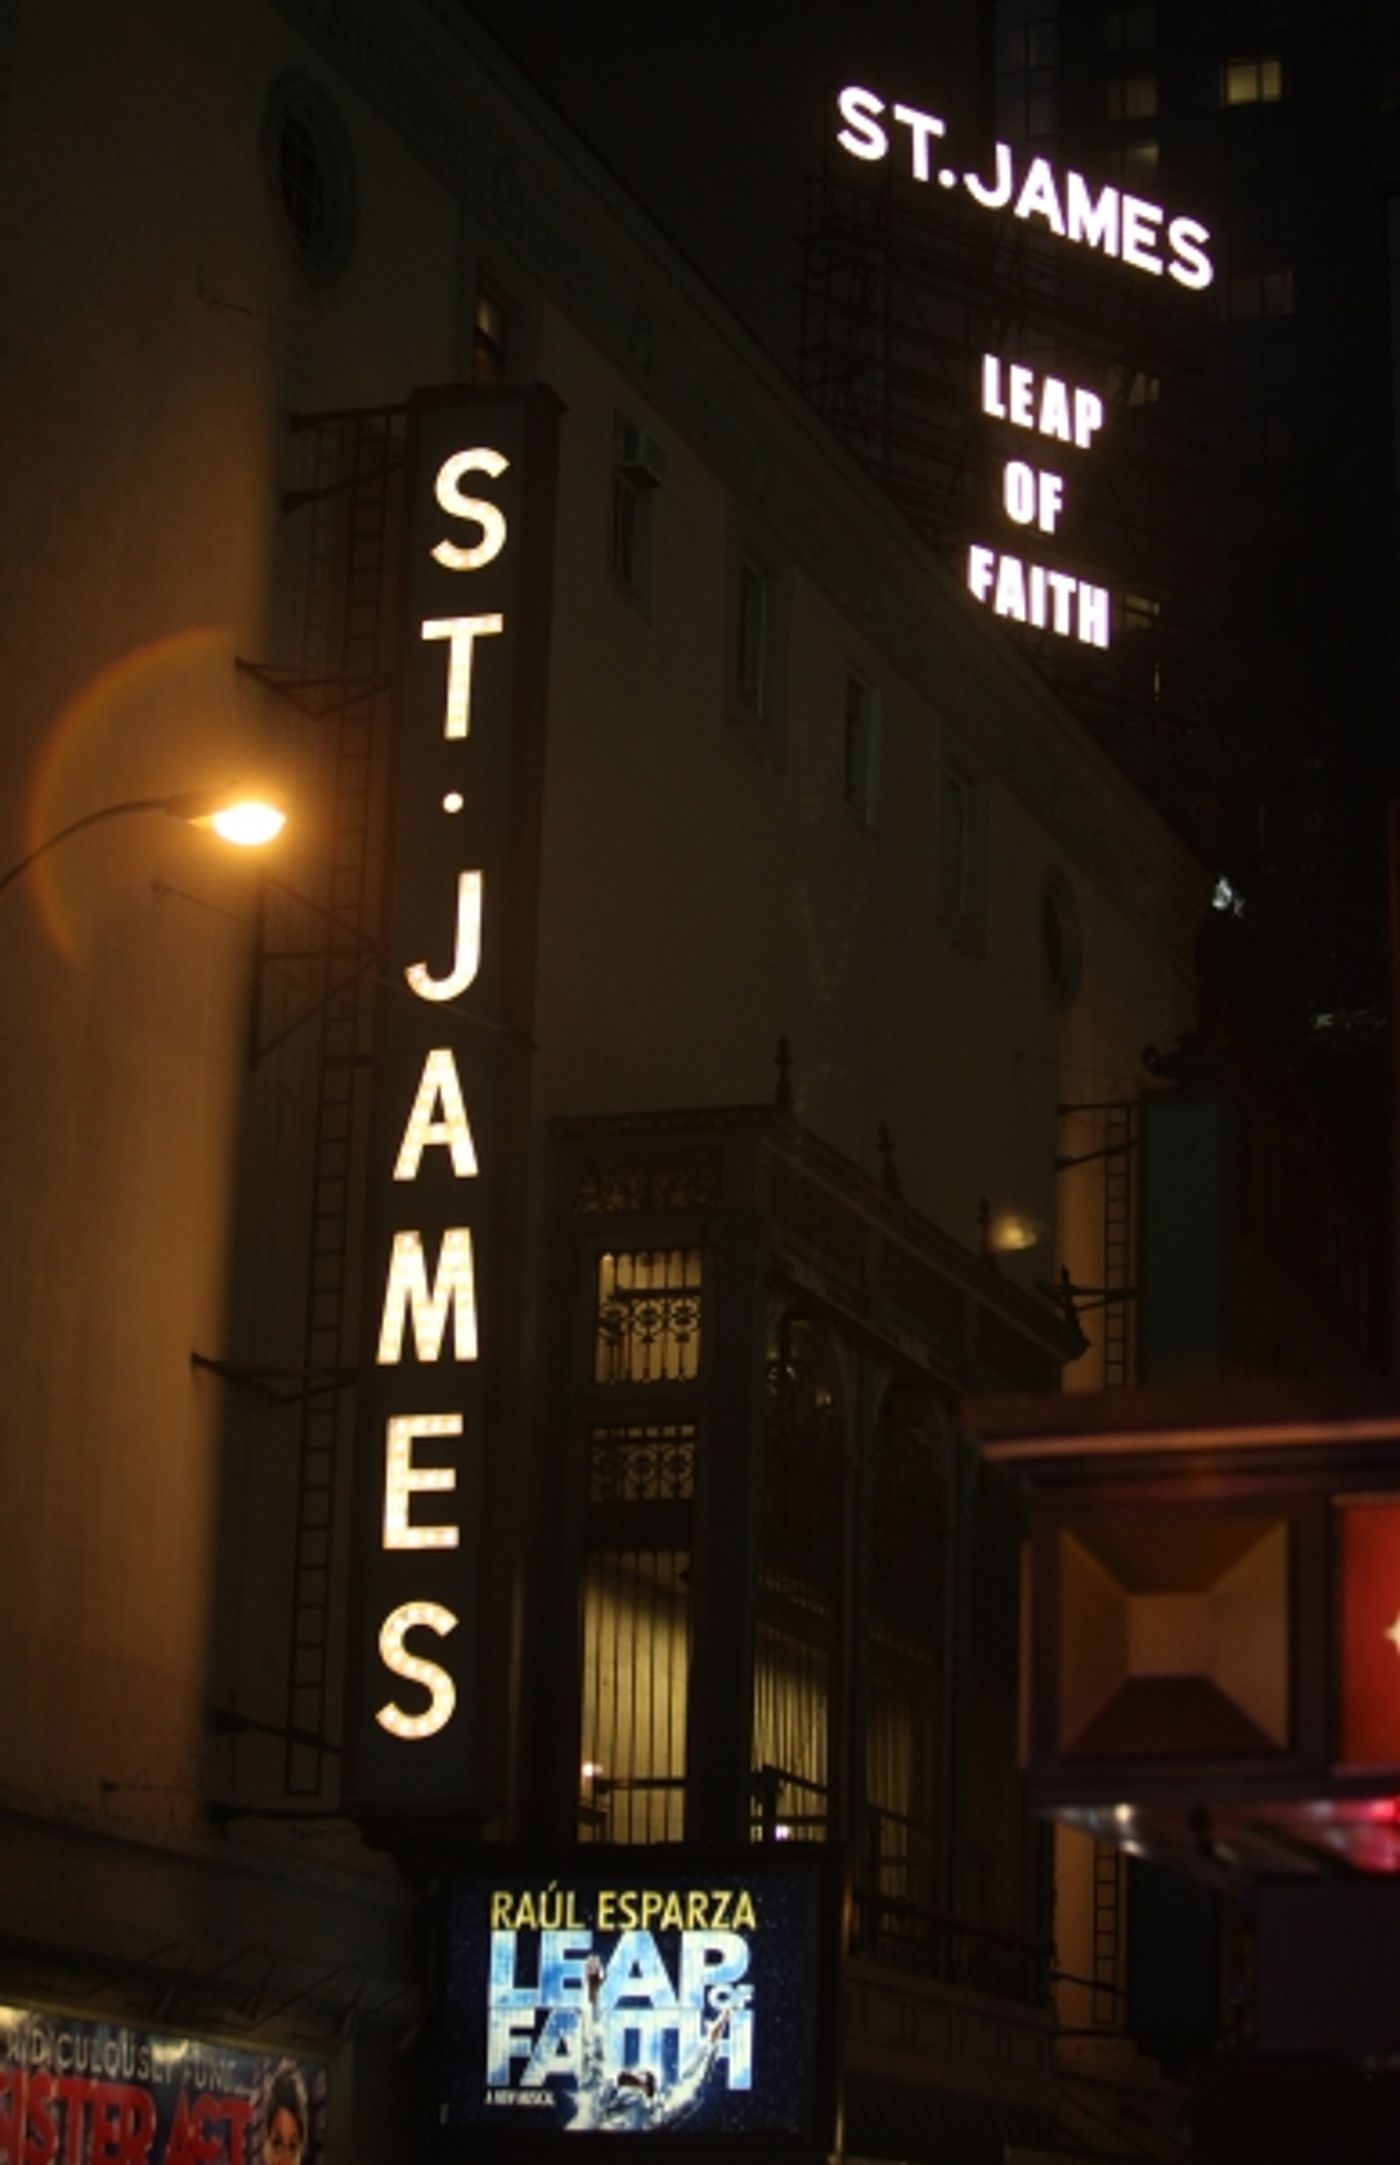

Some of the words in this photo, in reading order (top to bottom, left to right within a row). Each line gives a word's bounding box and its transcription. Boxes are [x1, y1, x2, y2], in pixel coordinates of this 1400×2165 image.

[837, 86, 956, 188] ST.
[963, 143, 1213, 290] JAMES
[982, 353, 1103, 449] LEAP
[1003, 460, 1062, 534] OF
[968, 544, 1109, 648] FAITH
[375, 869, 482, 1740] JAMES
[490, 1881, 585, 1930] RAÚL
[597, 1890, 757, 1931] ESPARZA
[489, 1930, 750, 2010] LEAP
[706, 1983, 754, 2010] OF
[486, 2007, 754, 2090] FAITH
[163, 2090, 253, 2165] ACT
